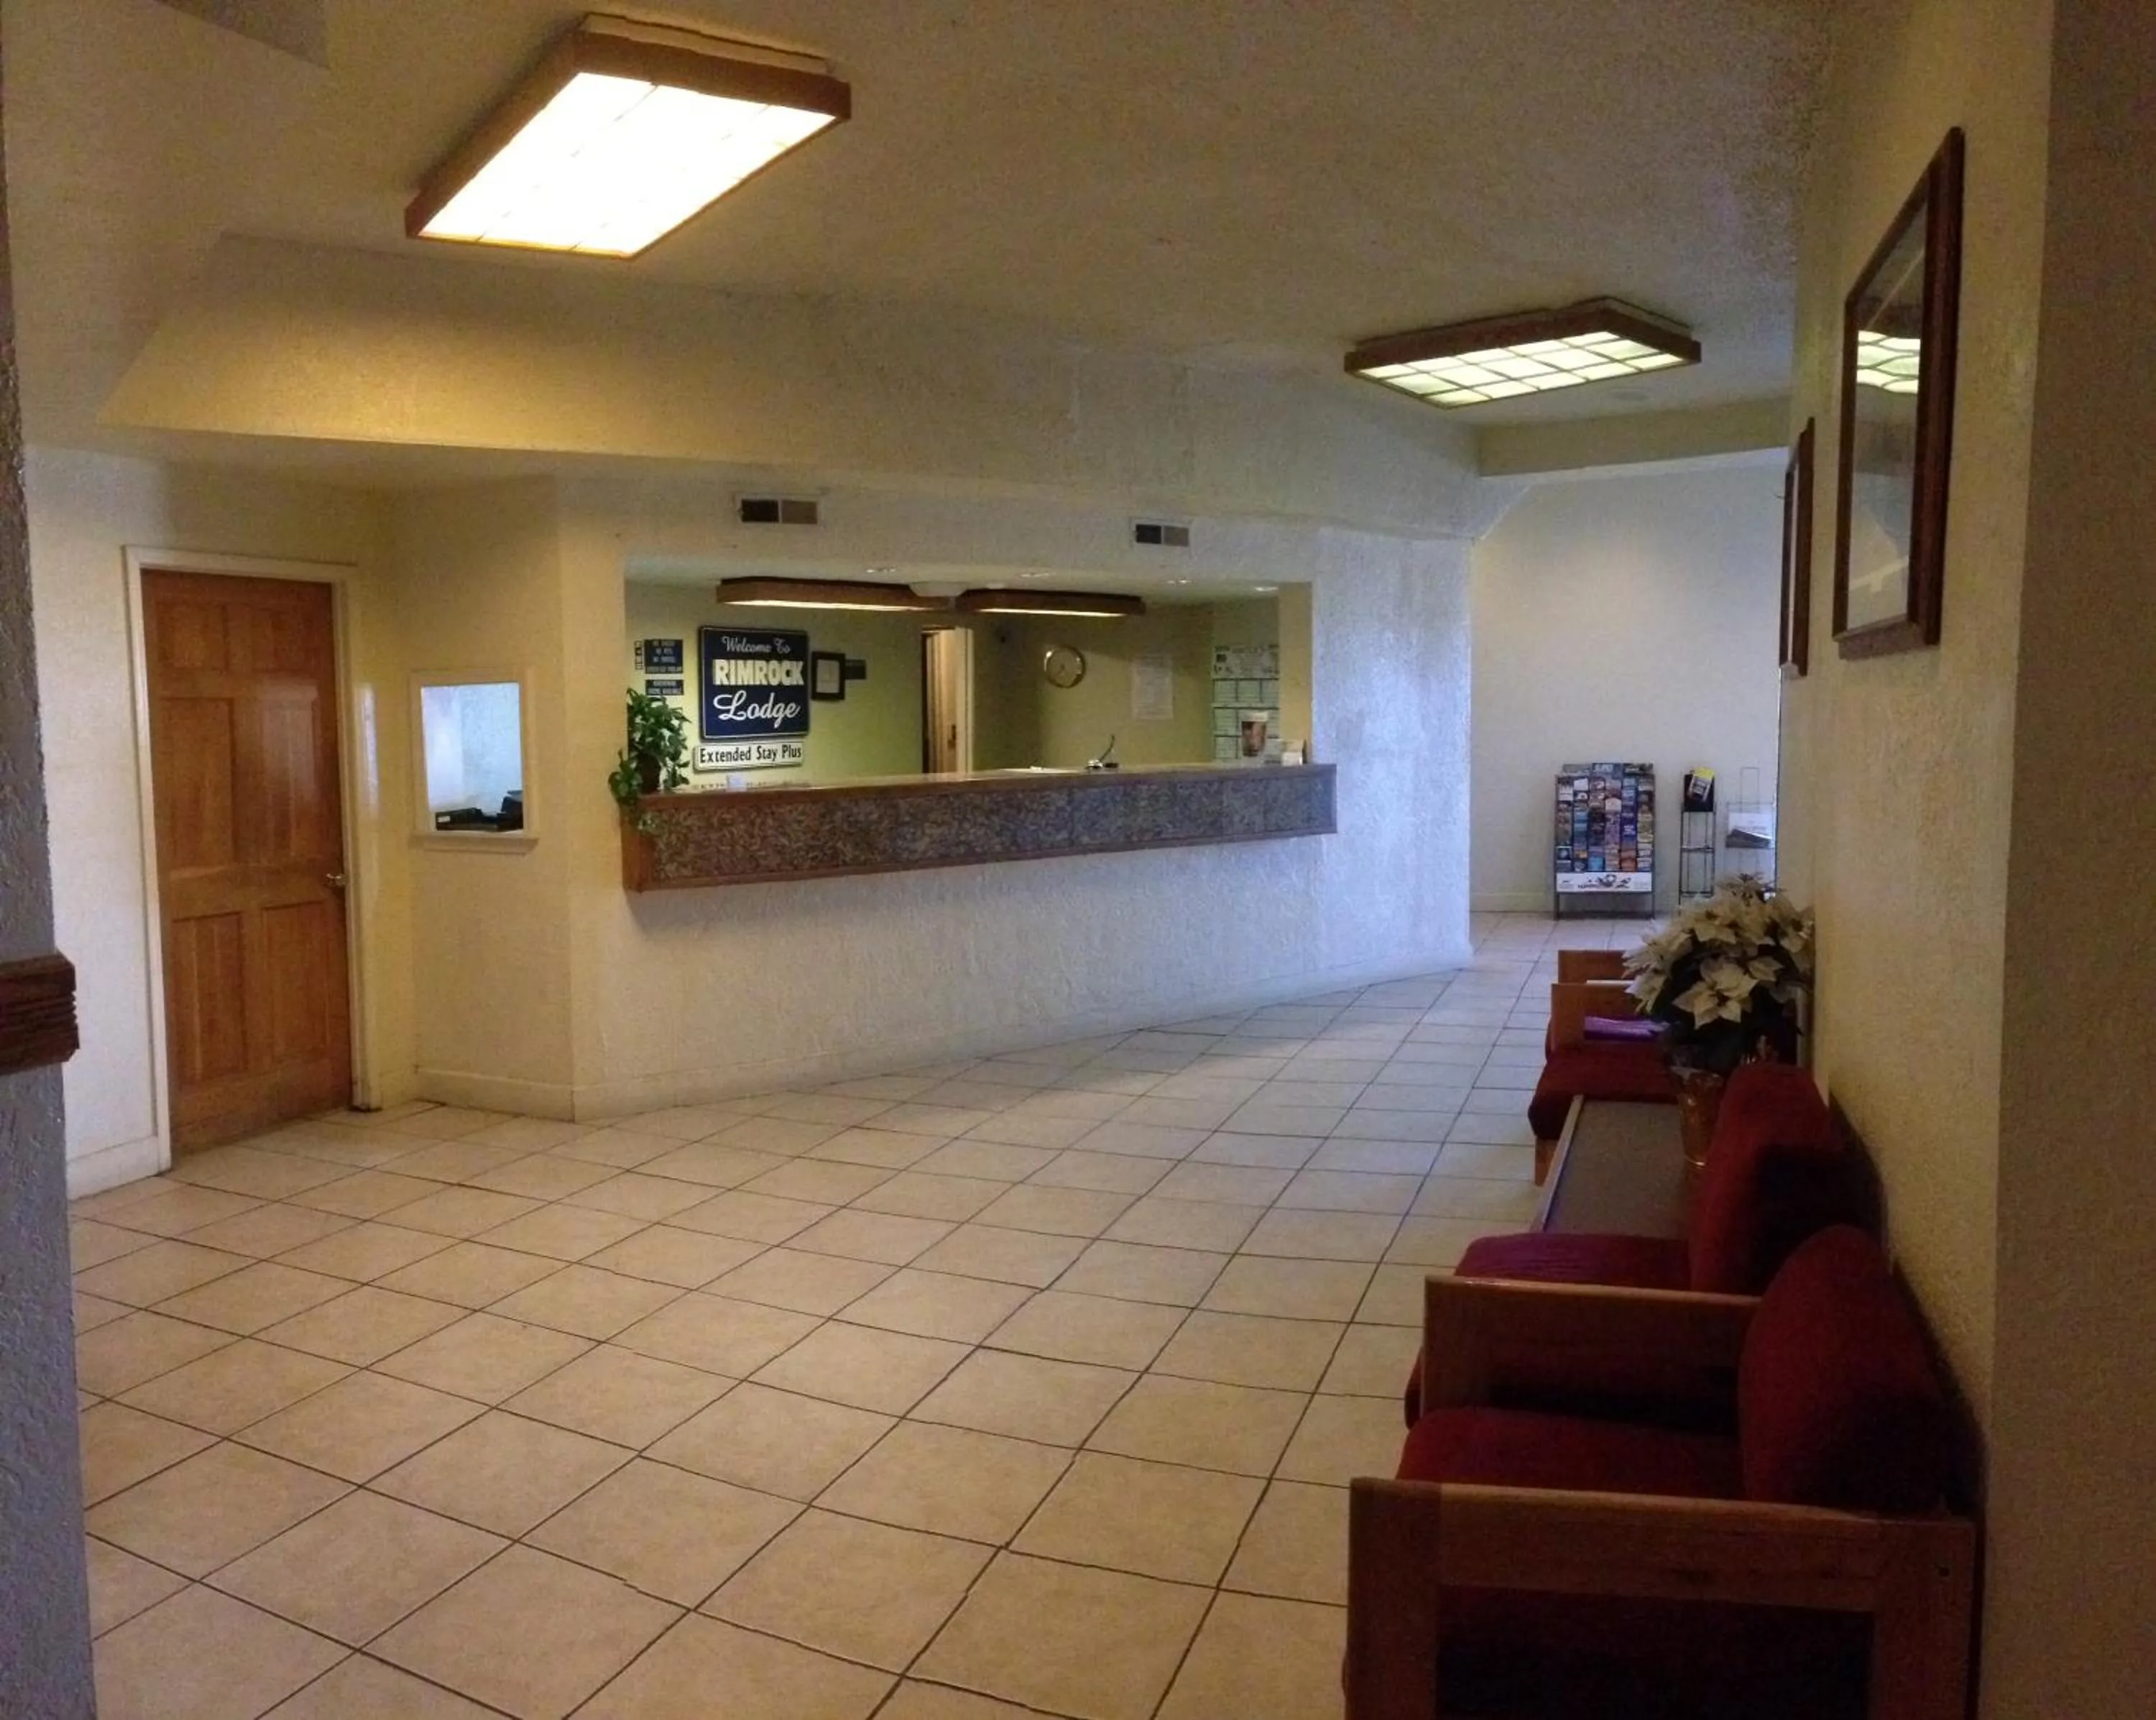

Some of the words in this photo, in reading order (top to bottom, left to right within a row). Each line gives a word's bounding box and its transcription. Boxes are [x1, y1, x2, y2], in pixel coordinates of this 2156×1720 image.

[722, 636, 772, 653] Welcome
[712, 659, 804, 686] RIMROCK
[713, 690, 801, 729] Lodge
[699, 746, 752, 764] Extended
[756, 745, 778, 762] Stay
[781, 744, 802, 759] Plus
